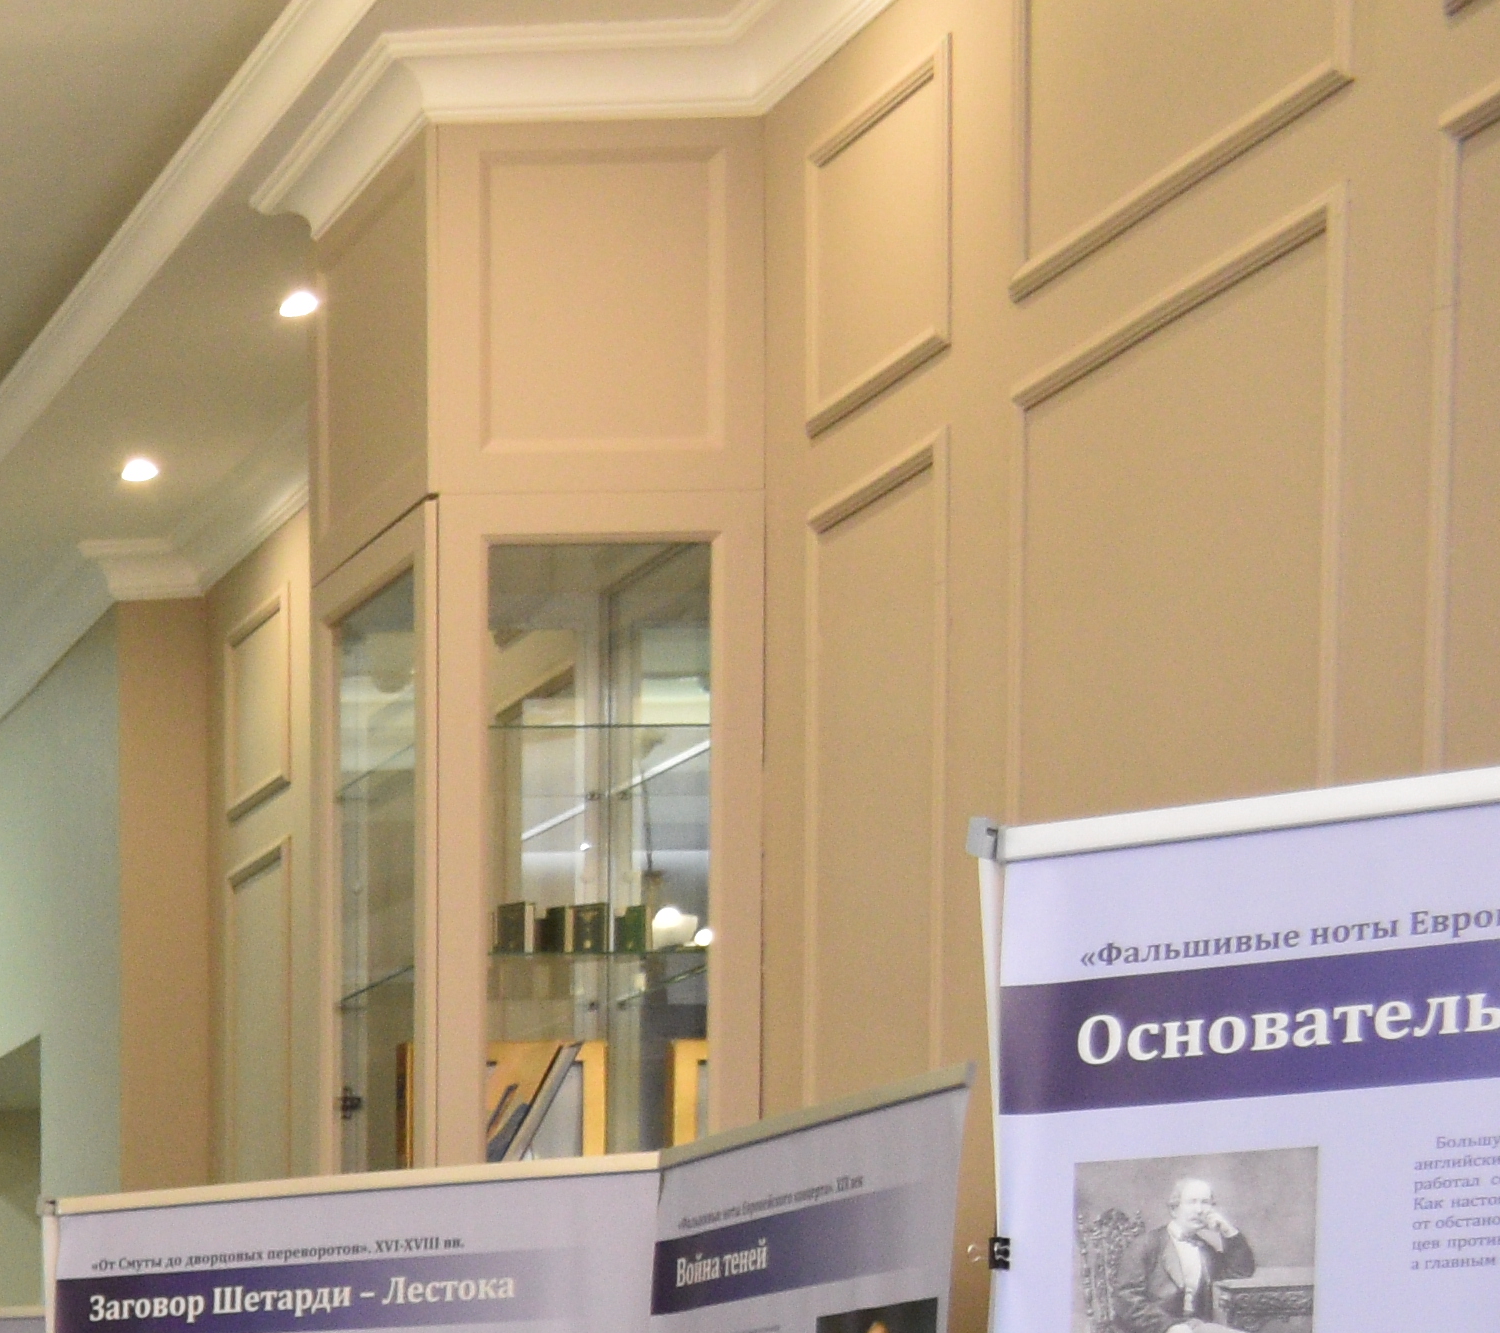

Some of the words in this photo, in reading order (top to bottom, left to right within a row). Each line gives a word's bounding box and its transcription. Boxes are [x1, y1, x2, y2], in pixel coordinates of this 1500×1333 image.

[1080, 928, 1301, 968] «Фальшивые
[1310, 916, 1399, 948] ноты
[1409, 908, 1500, 938] Евро
[91, 1257, 117, 1272] «От
[118, 1256, 163, 1273] Смуты
[164, 1255, 183, 1270] до
[184, 1250, 264, 1269] дворцовых
[266, 1244, 372, 1265] переворотов».
[375, 1235, 440, 1254] XVI-XVIII
[443, 1237, 465, 1250] вв.
[676, 1252, 721, 1288] Война
[722, 1236, 768, 1278] теней
[89, 1293, 205, 1325] Заговор
[212, 1285, 352, 1319] Шетарди
[381, 1274, 516, 1305] Лестока
